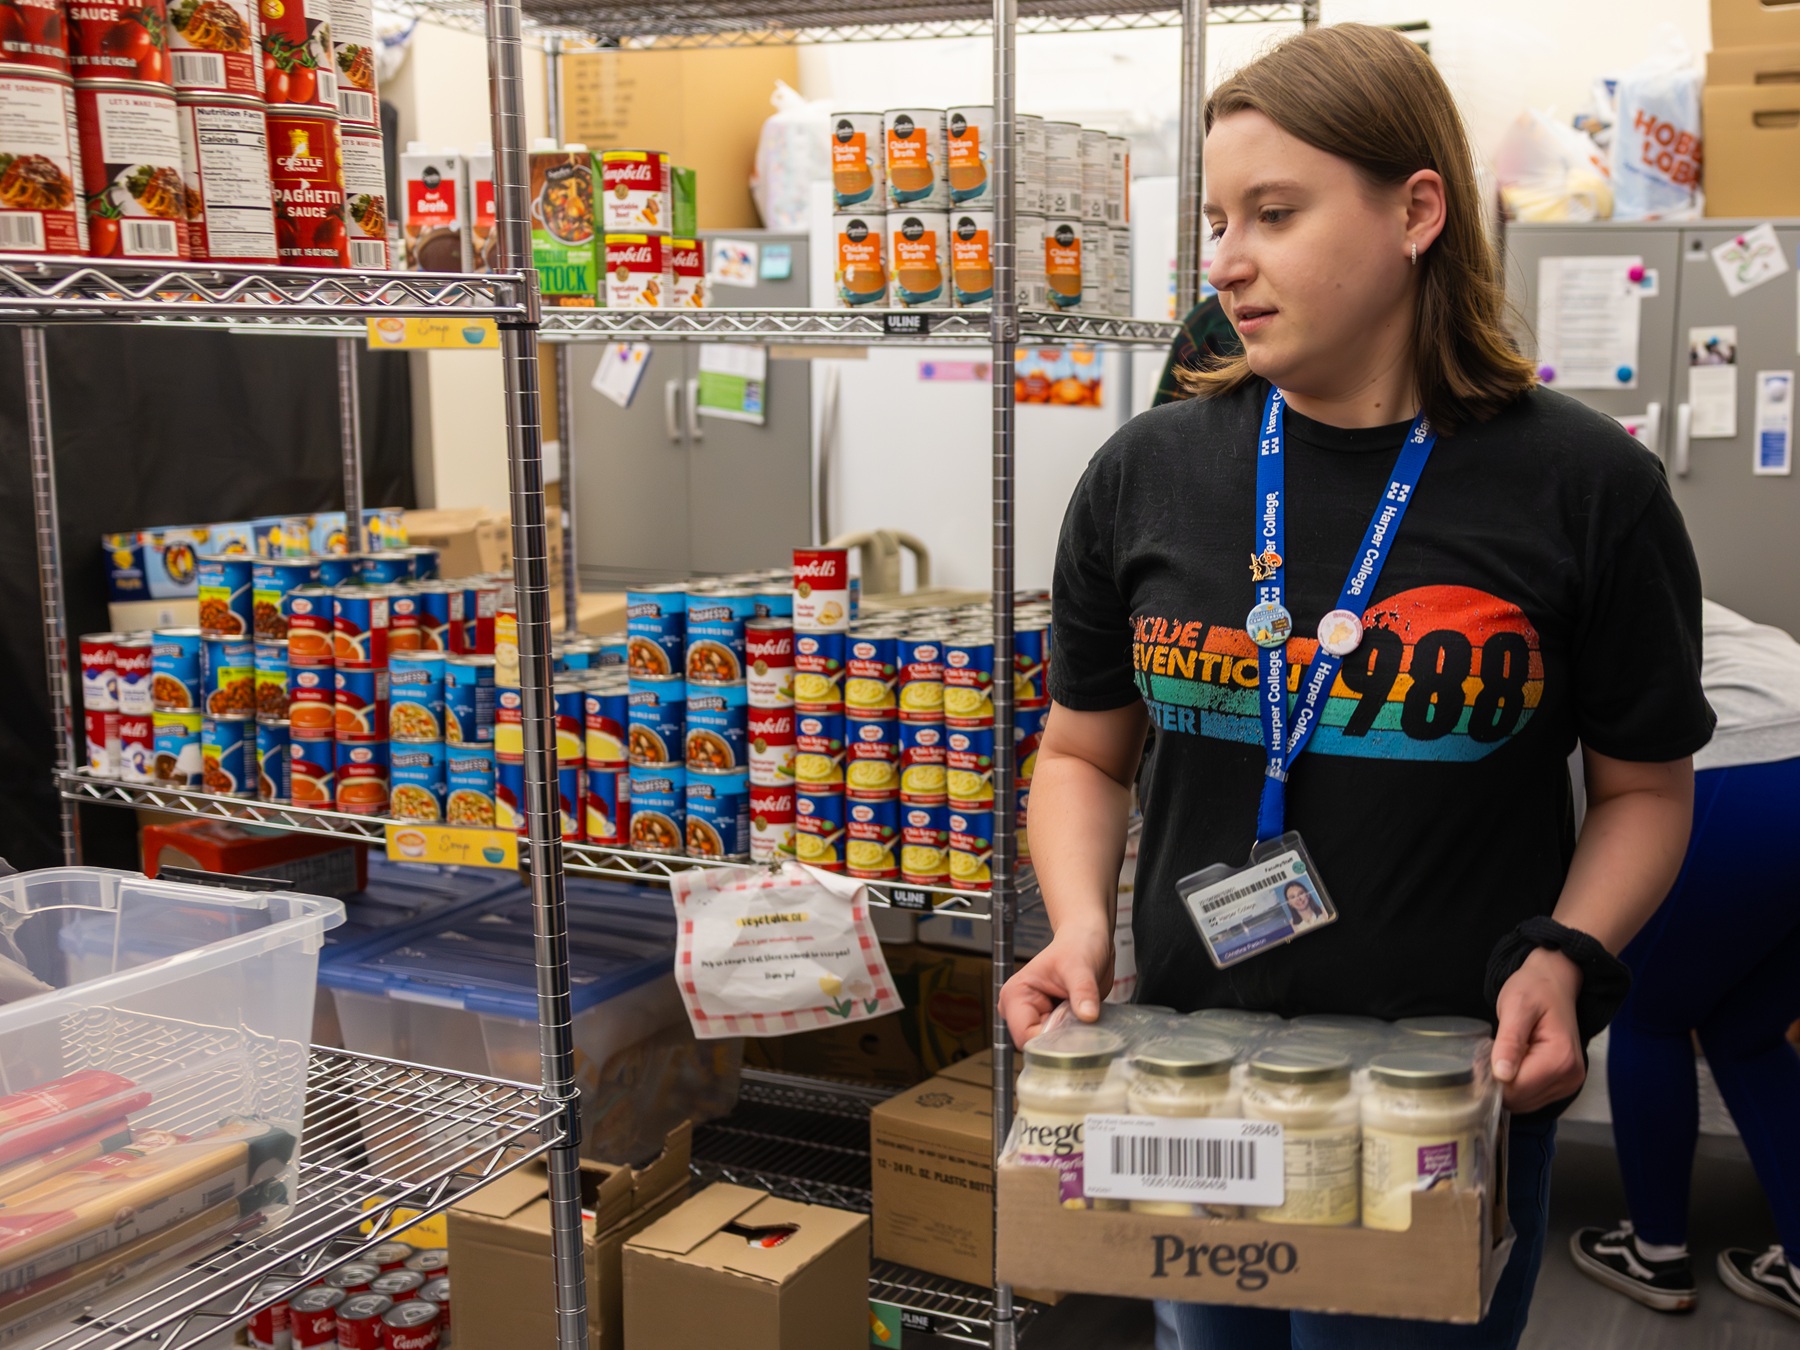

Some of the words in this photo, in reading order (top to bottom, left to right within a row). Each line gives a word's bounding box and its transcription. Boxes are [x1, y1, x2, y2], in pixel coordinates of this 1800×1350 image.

[70, 8, 120, 22] SAUCE
[197, 109, 241, 118] Nutrition
[200, 135, 239, 144] Calories
[889, 140, 921, 151] Chicken
[835, 153, 856, 163] Broth
[893, 149, 917, 159] Broth
[276, 157, 324, 168] CASTLE
[417, 199, 449, 213] Broth
[287, 206, 327, 218] SAUCE
[841, 243, 875, 254] Chicken
[897, 242, 931, 253] Chicken
[1049, 247, 1079, 258] Chicken
[846, 252, 871, 262] Broth
[901, 250, 926, 261] Broth
[956, 250, 979, 261] Broth
[1053, 255, 1077, 266] Broth
[888, 315, 921, 328] ULINE
[1265, 401, 1281, 435] Harper
[1371, 505, 1398, 548] Harper
[795, 655, 826, 666] Chicken
[849, 659, 883, 671] Chicken
[850, 667, 881, 678] Noodle
[908, 663, 944, 672] Chicken
[944, 667, 978, 679] Chicken
[944, 675, 975, 686] Noodle
[1305, 661, 1332, 707] Harper
[1341, 628, 1530, 744] 988
[296, 691, 322, 700] Tomato
[1271, 705, 1283, 751] Harper
[797, 735, 829, 746] Chicken
[798, 743, 826, 753] Noodle
[853, 742, 890, 752] Chicken
[910, 746, 947, 756] Chicken
[855, 750, 887, 759] Noodle
[912, 753, 944, 763] Noodle
[348, 767, 376, 775] Tomato
[848, 822, 881, 833] Chicken
[904, 827, 938, 838] Chicken
[849, 830, 879, 840] Noodle
[905, 835, 935, 845] Noodle
[893, 889, 926, 905] ULINE
[748, 956, 763, 964] that
[764, 953, 782, 962] there
[1241, 1122, 1280, 1138] 28645
[877, 1157, 887, 1168] 12
[904, 1164, 917, 1177] FL.
[918, 1167, 931, 1180] OZ.
[934, 1170, 968, 1189] PLASTIC
[1150, 1233, 1299, 1293] Prego
